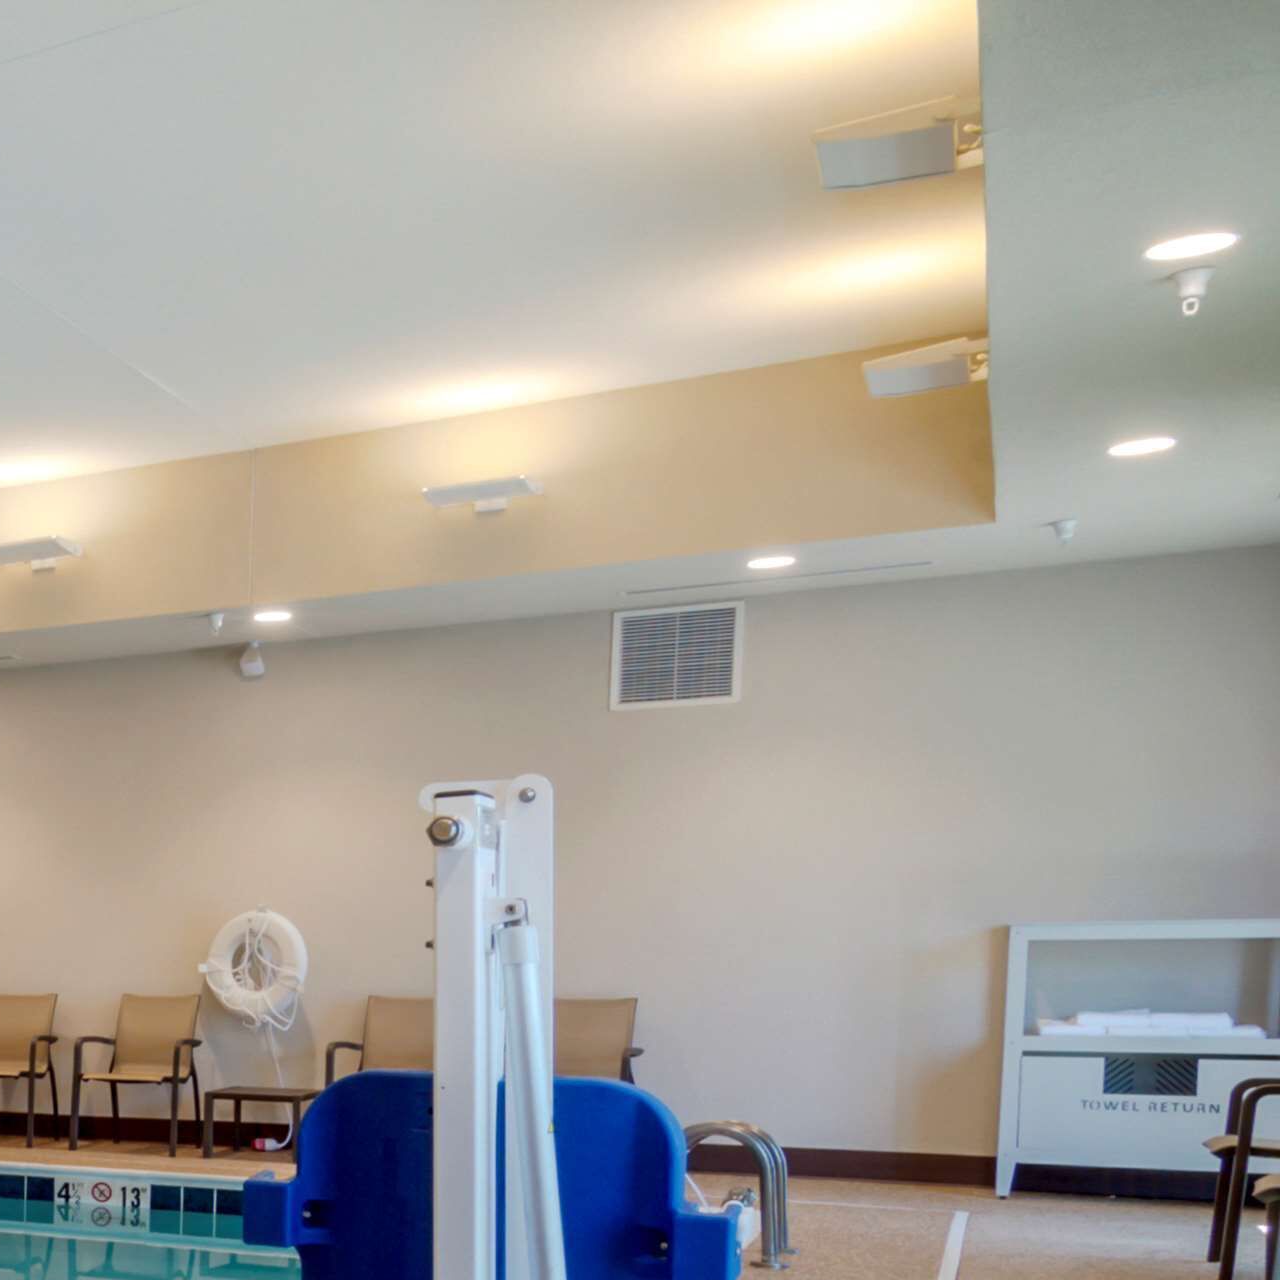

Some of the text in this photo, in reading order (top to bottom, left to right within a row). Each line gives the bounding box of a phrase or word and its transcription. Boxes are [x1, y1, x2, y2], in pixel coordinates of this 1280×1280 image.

[1080, 1099, 1221, 1114] TOWEL RETURN
[57, 1182, 70, 1202] 4
[121, 1186, 140, 1208] 13
